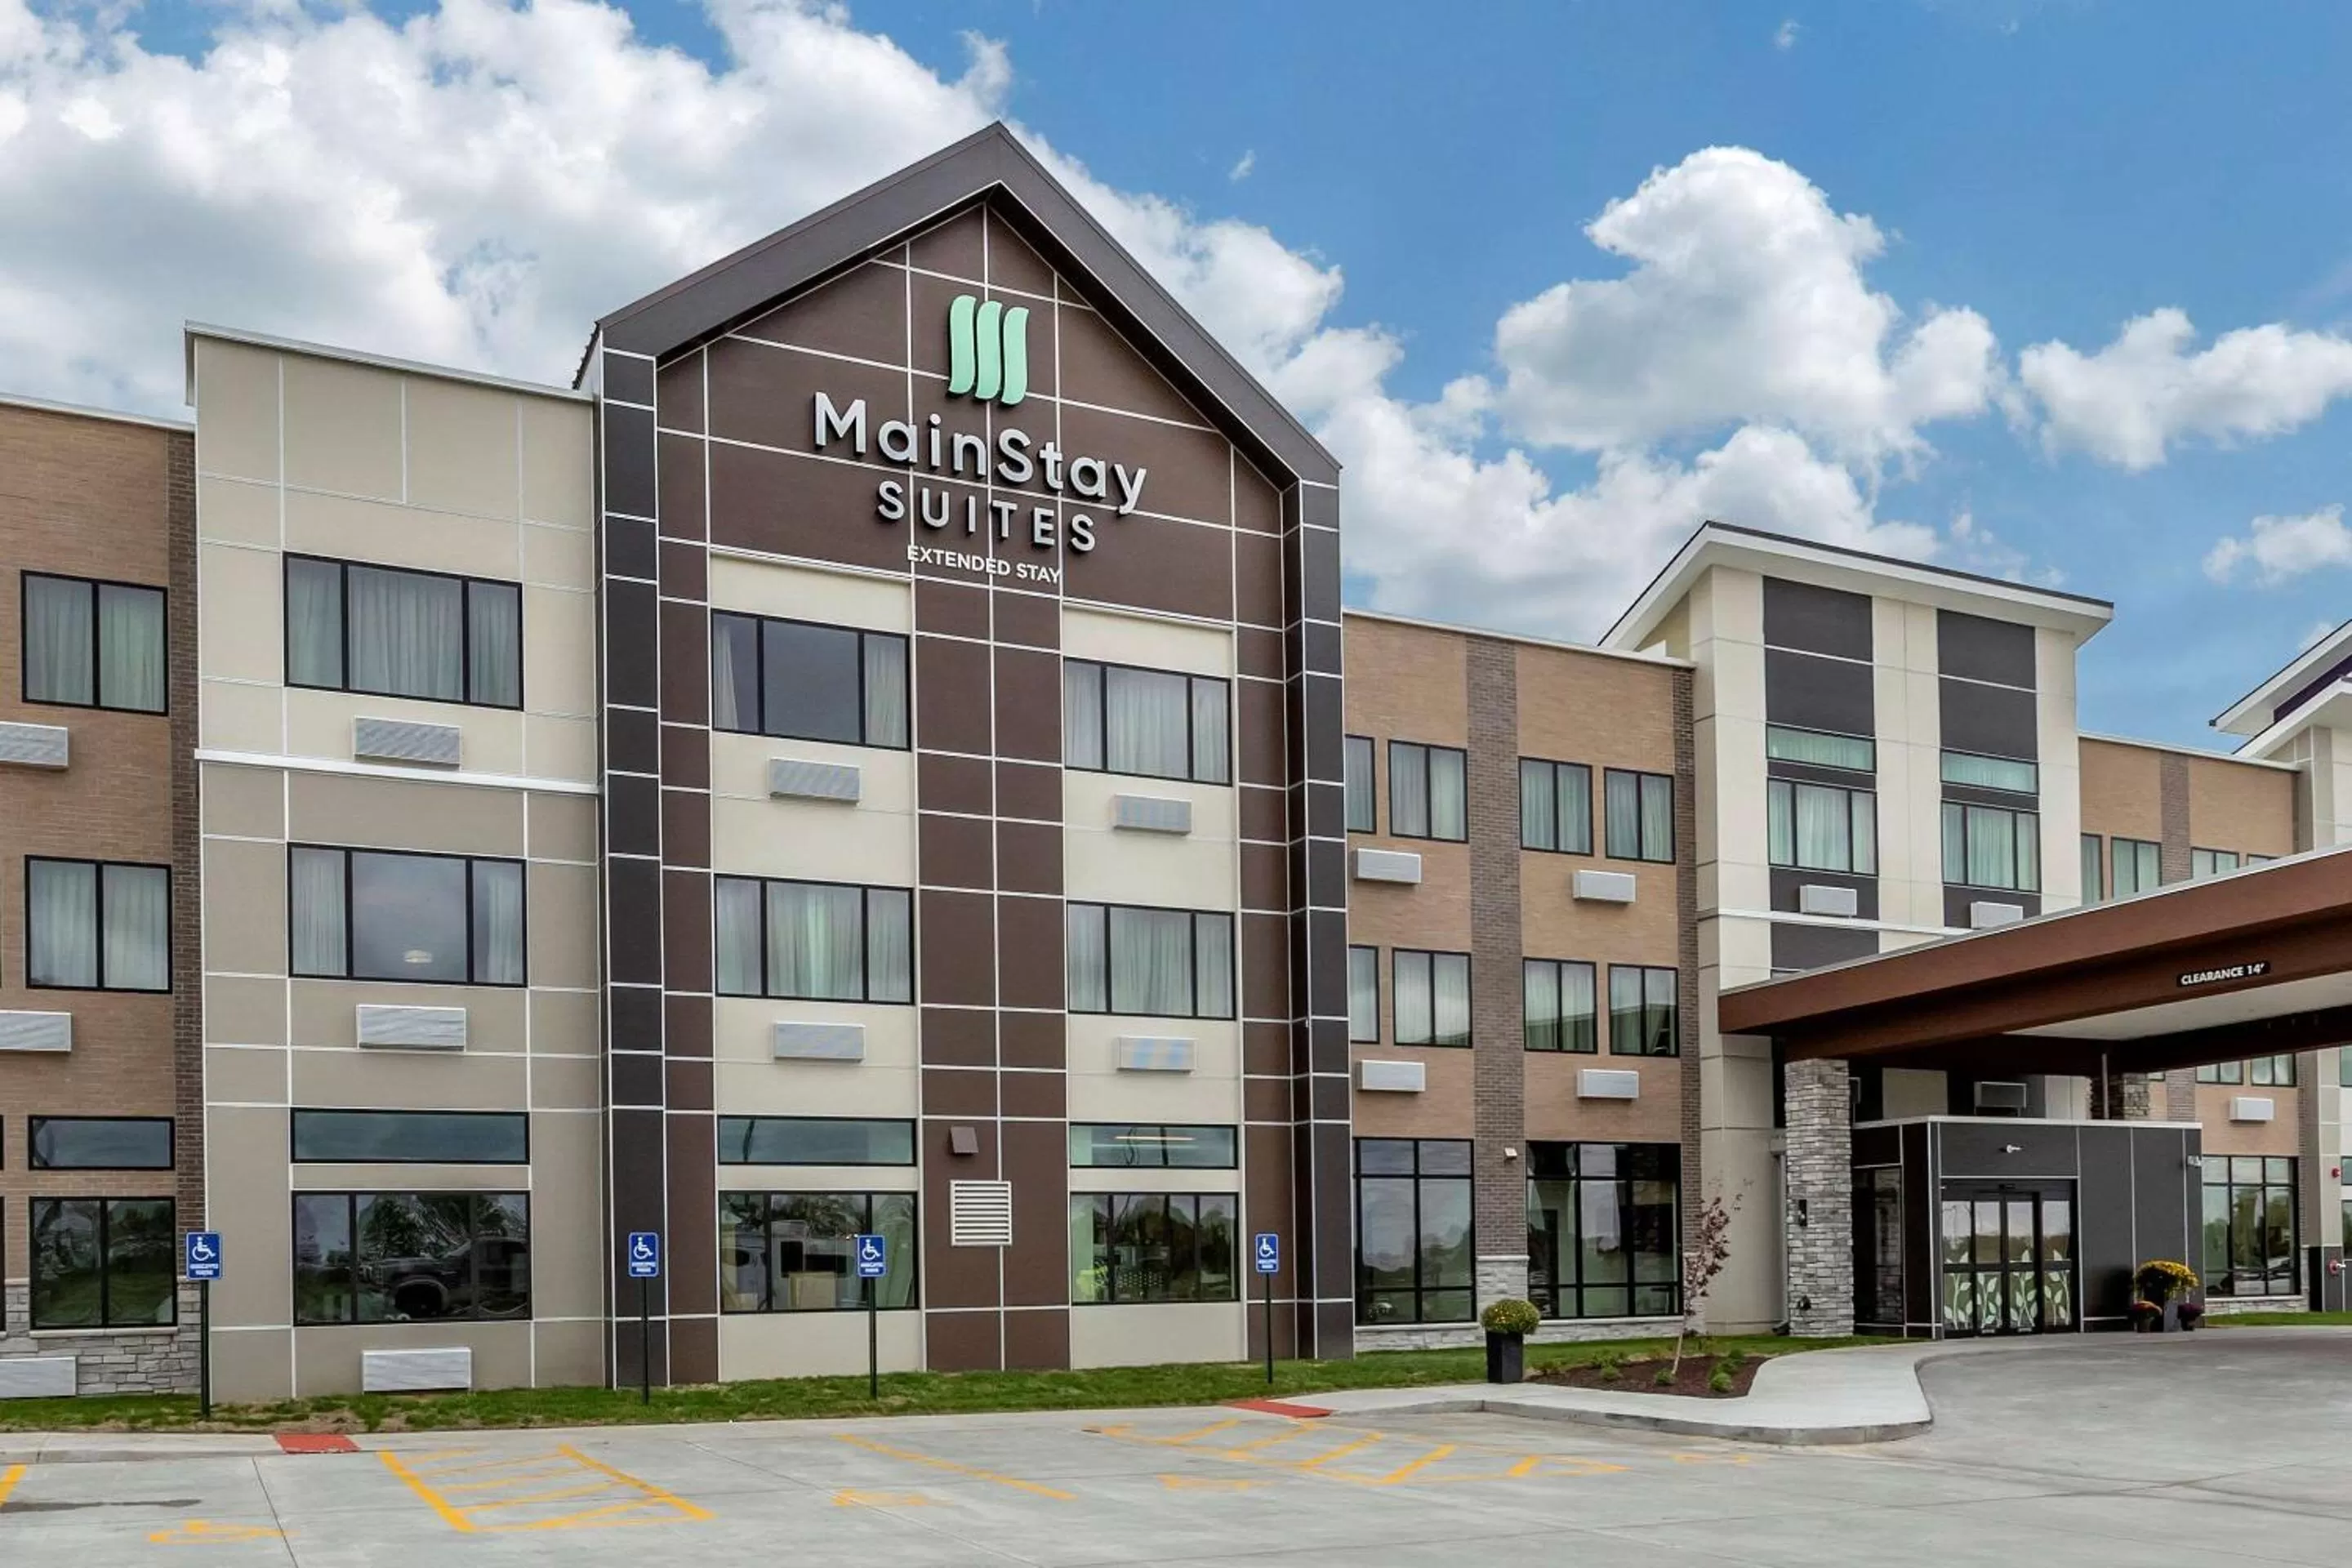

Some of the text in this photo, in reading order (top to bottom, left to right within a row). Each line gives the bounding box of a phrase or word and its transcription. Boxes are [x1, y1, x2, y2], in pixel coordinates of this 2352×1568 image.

[814, 391, 1147, 515] MainStay
[877, 480, 1095, 552] SUITES
[907, 546, 1060, 584] EXTENDED STAY
[2180, 966, 2244, 986] CLEARANCE
